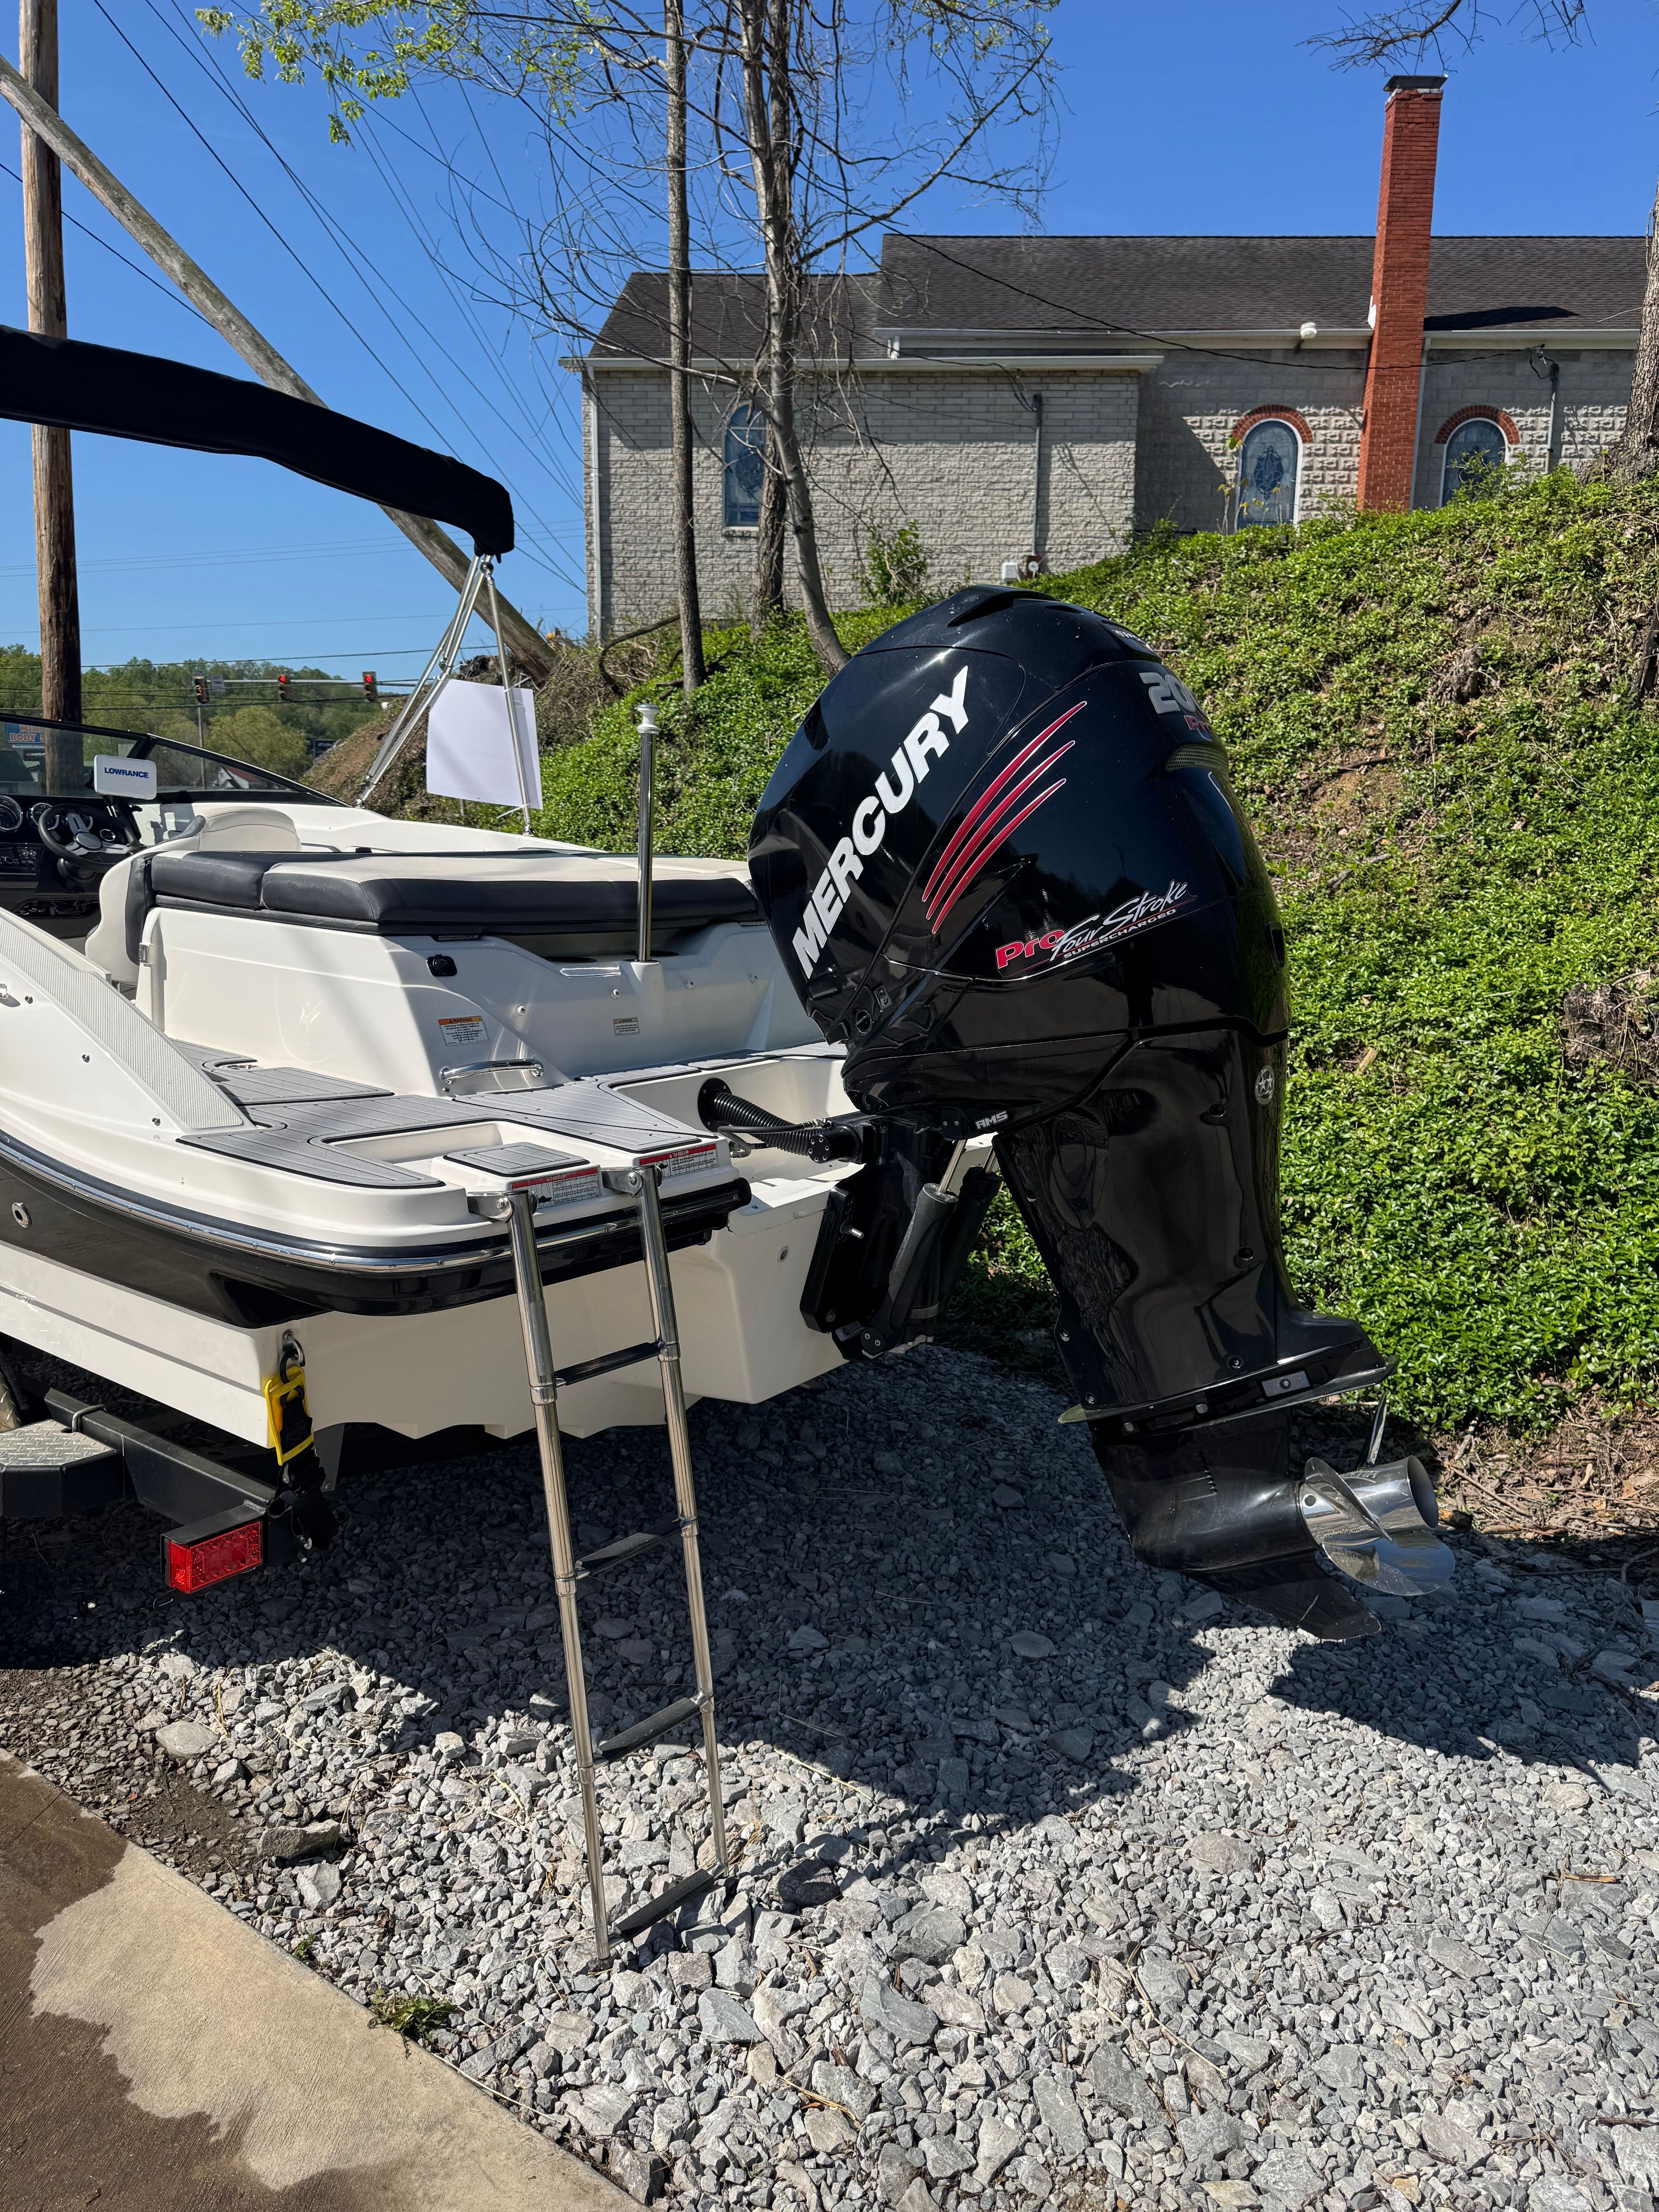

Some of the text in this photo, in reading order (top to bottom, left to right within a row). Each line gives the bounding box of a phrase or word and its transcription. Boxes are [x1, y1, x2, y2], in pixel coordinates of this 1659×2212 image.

[1139, 672, 1207, 714] 20
[10, 733, 36, 741] BODY
[104, 767, 149, 778] LOWRANCE
[792, 665, 969, 979] MERCURY
[996, 879, 1188, 969] Pro Four Stroke
[1063, 909, 1176, 959] SUPERCHARGED
[976, 1111, 1008, 1129] AMS
